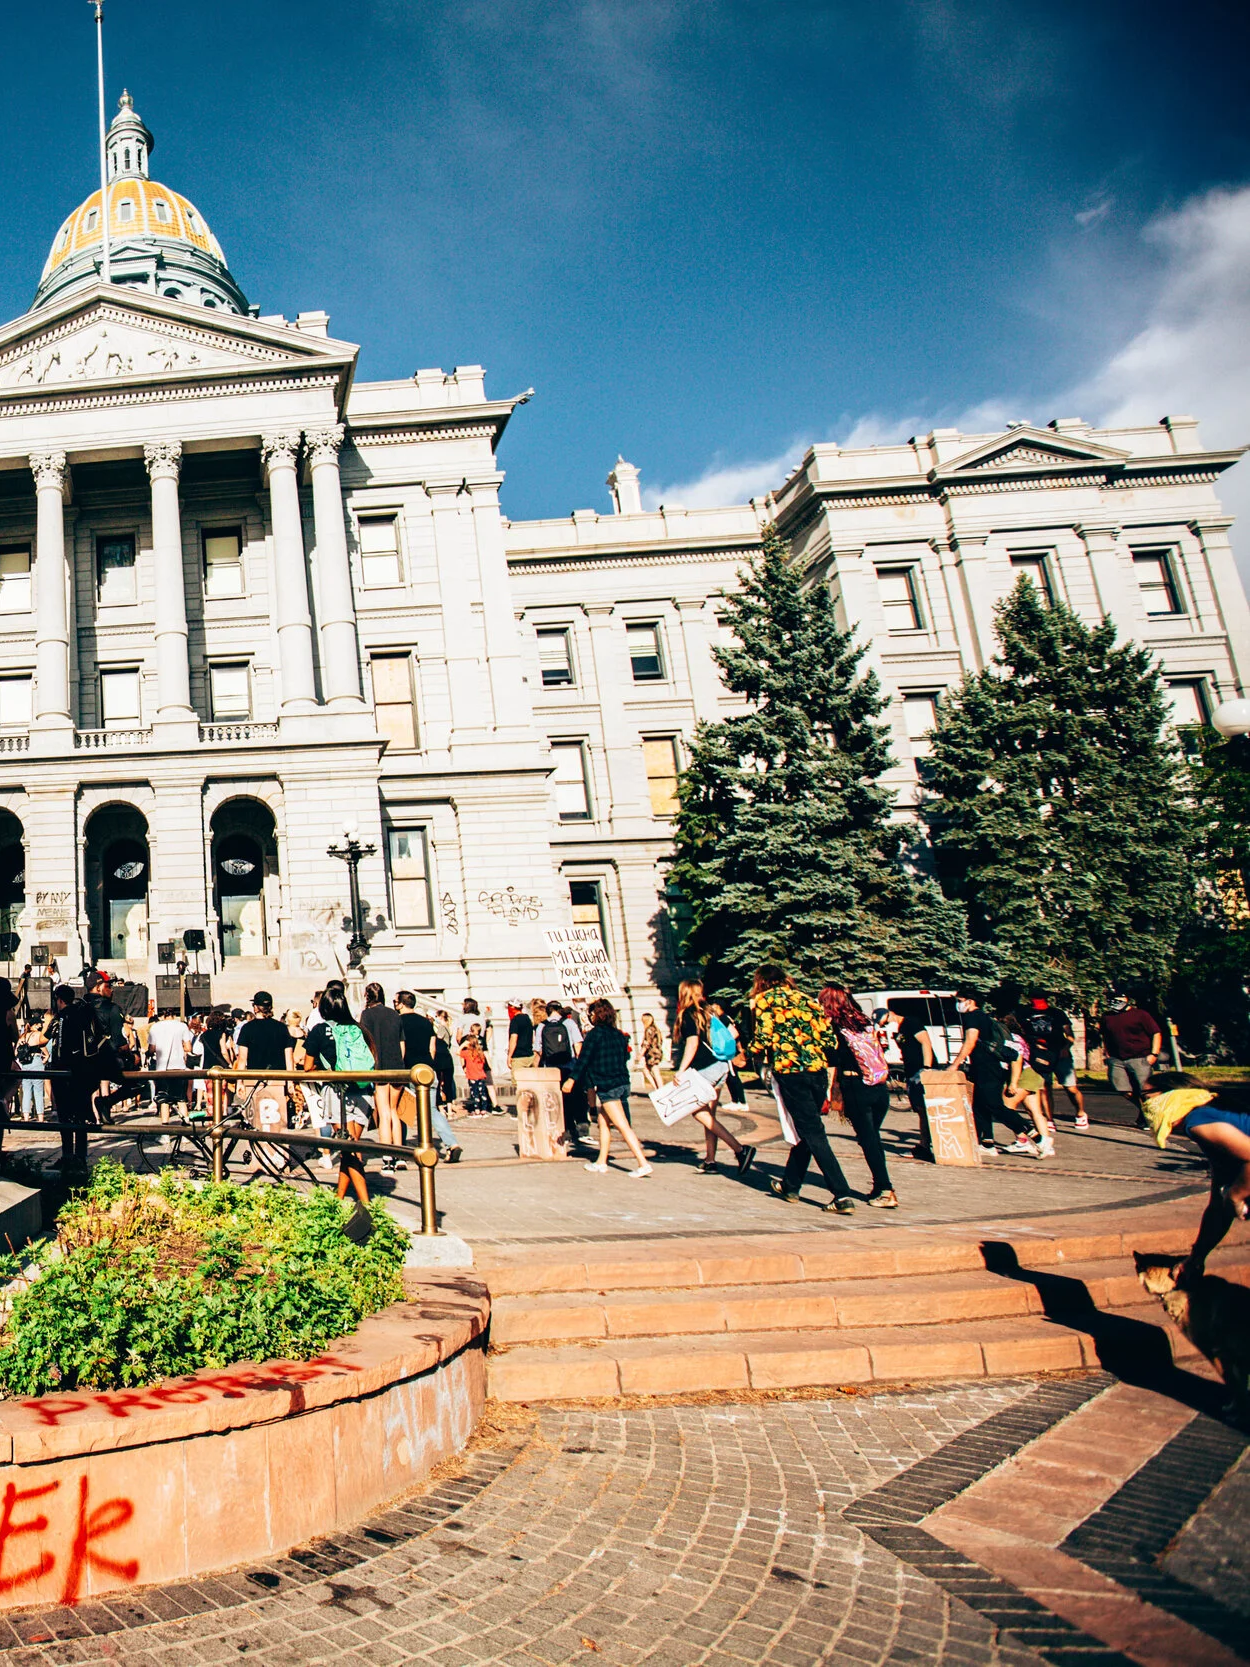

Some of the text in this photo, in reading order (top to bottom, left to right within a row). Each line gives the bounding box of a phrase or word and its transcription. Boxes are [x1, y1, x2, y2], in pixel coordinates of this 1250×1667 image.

[36, 892, 71, 904] BY ANY
[478, 890, 543, 907] GEORGE
[544, 930, 563, 943] TU
[551, 949, 569, 965] MI
